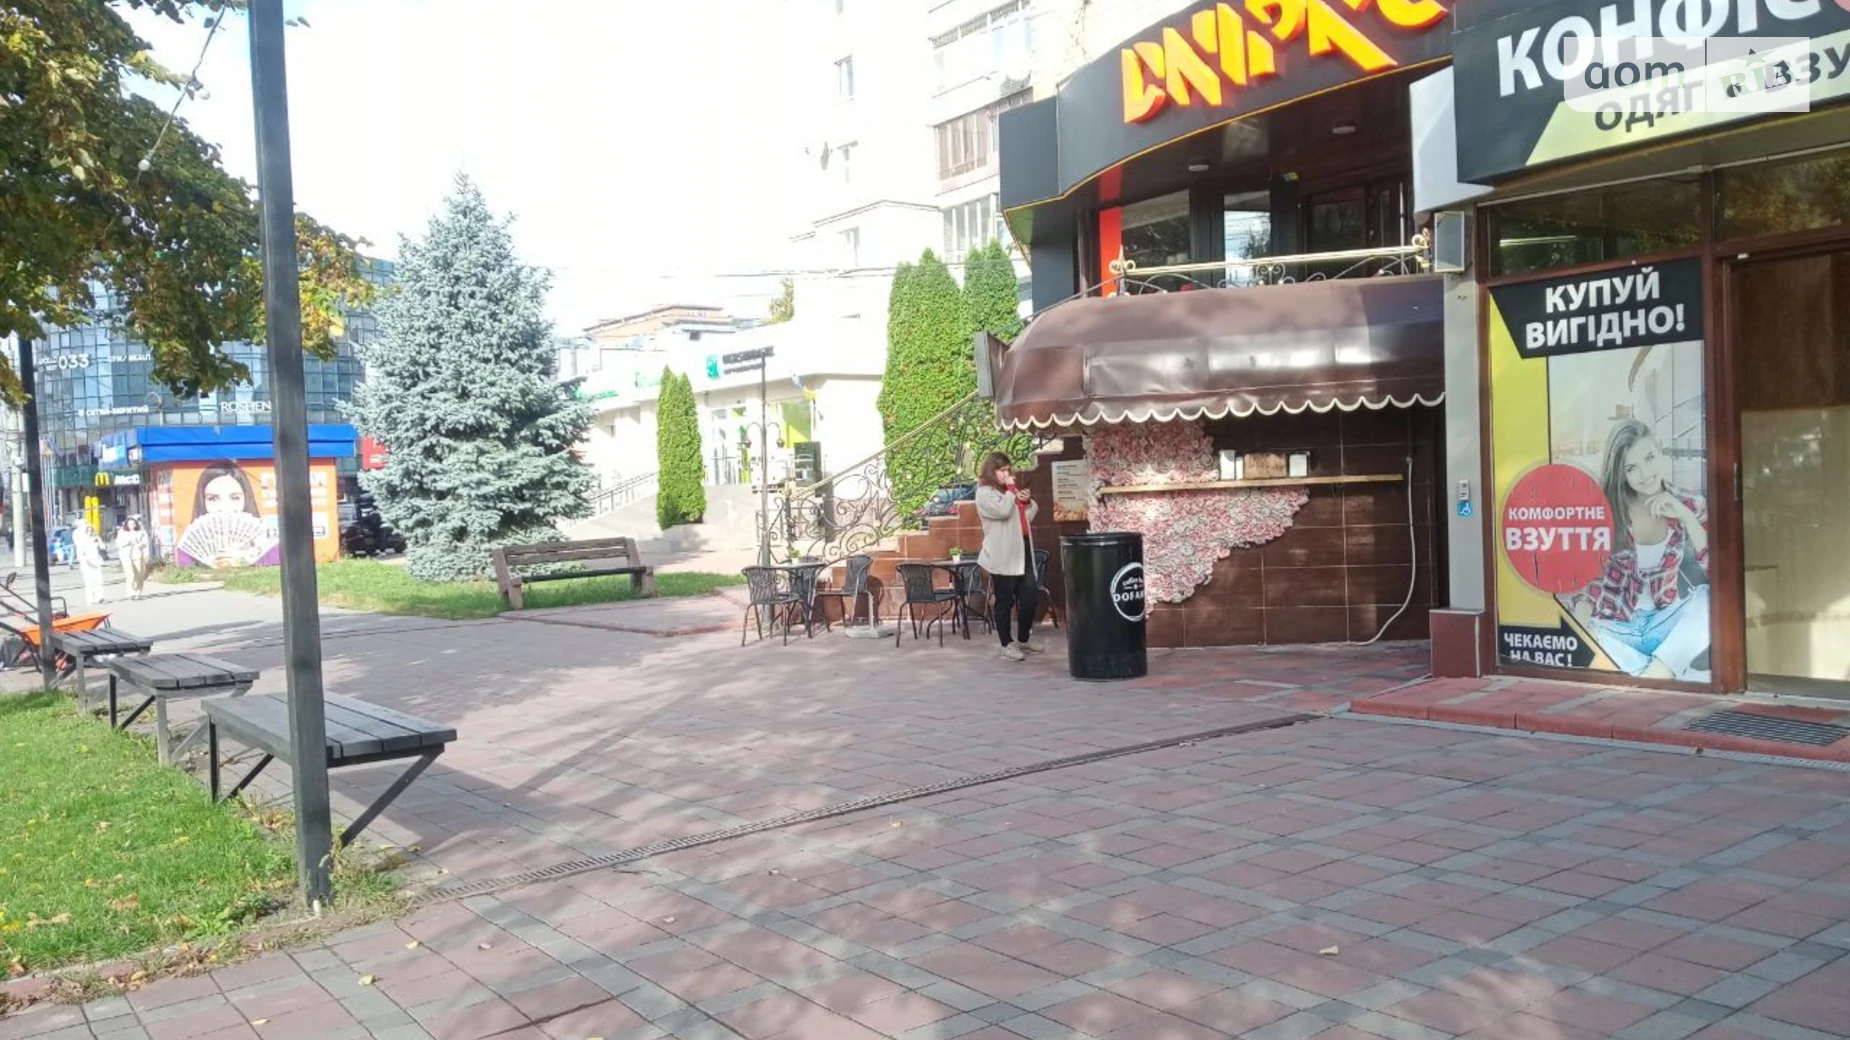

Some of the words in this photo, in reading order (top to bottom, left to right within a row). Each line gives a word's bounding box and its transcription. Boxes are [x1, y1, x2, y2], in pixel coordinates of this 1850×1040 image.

[1595, 80, 1704, 132] ОДЯГ
[1545, 266, 1660, 313] КУПУЙ
[1525, 303, 1685, 349] ВИГІДНО!
[220, 401, 272, 414] ROSHEN
[1508, 506, 1605, 520] КОМФОРТНЕ
[1505, 527, 1611, 551] ВЗУТТЯ
[1504, 632, 1578, 651] ЧЕКАЄМО
